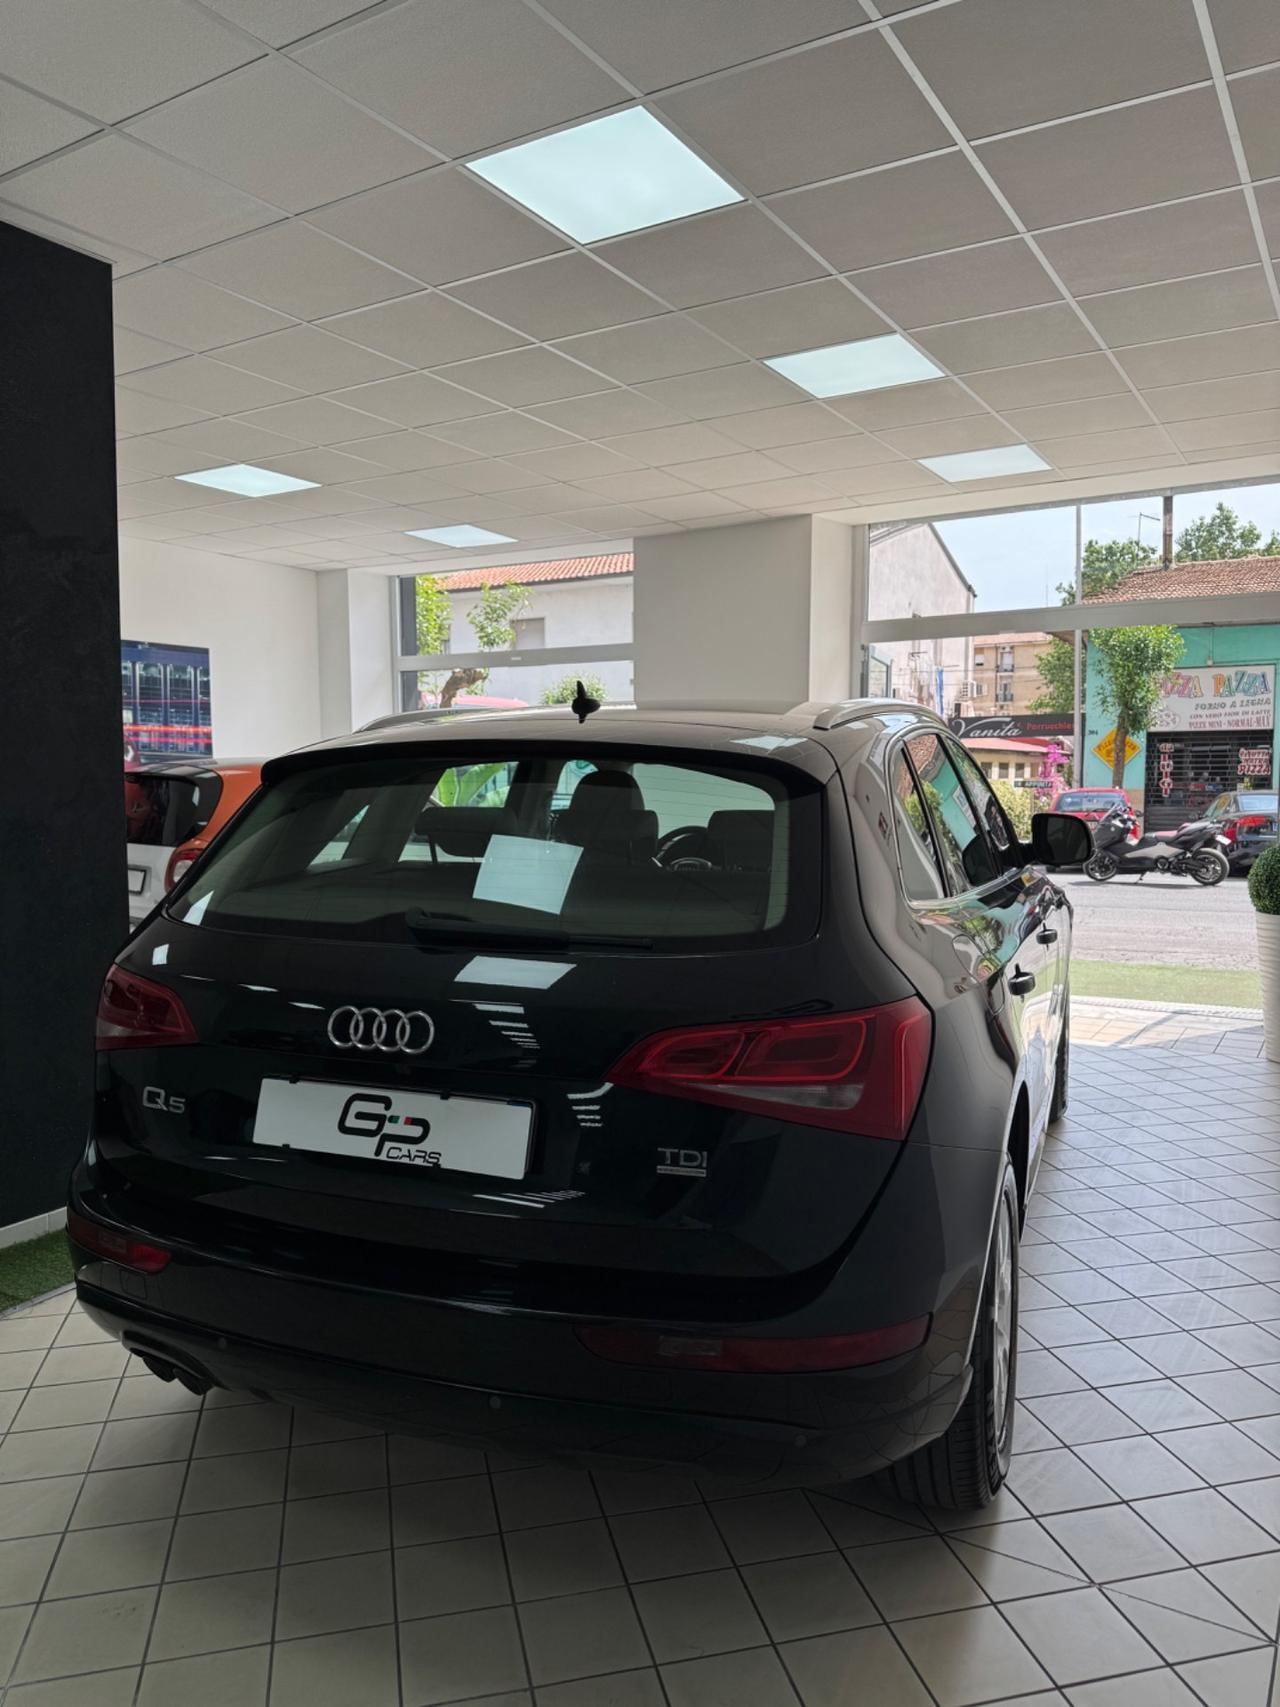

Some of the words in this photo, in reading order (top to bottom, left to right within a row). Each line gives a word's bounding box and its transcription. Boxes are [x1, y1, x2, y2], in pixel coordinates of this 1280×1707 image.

[1212, 670, 1272, 698] PAZZA
[1237, 764, 1271, 775] PIZZA
[143, 1086, 186, 1114] Q5
[337, 1092, 431, 1158] GP
[386, 1146, 442, 1165] CARS
[657, 1147, 708, 1168] TDI
